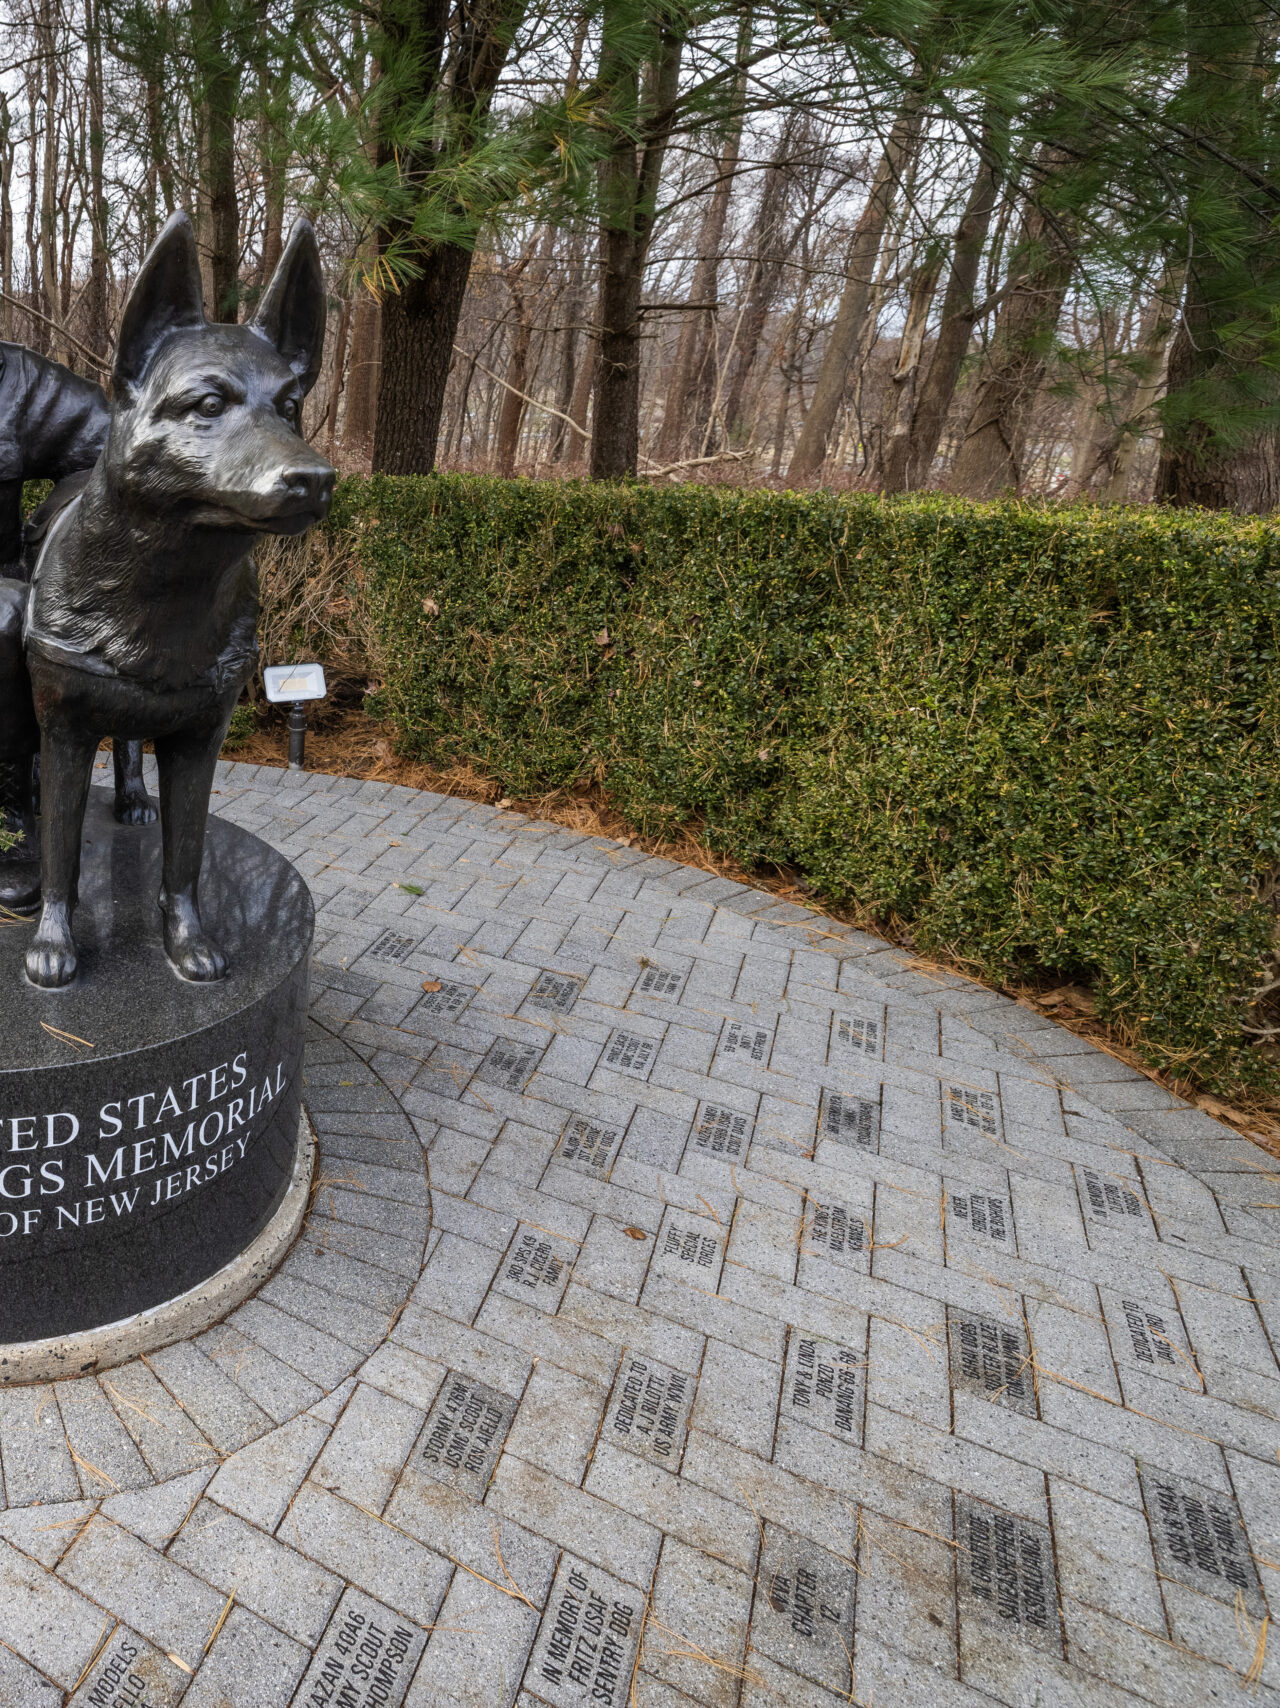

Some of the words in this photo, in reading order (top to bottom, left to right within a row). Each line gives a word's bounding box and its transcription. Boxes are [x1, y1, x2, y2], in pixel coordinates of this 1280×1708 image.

[98, 1051, 248, 1139] STATES
[83, 1061, 287, 1189] MEMORIAL
[583, 1127, 602, 1148] MARINE
[732, 1117, 747, 1135] DAVIS
[562, 1137, 580, 1159] MAJOR
[591, 1146, 609, 1168] SCOUT
[600, 1130, 616, 1147] DOGS
[727, 1134, 741, 1155] SCOUT
[55, 1187, 142, 1230] NEW
[150, 1131, 252, 1205] JERSEY
[1083, 1170, 1099, 1179] OF
[953, 1196, 967, 1219] NEVER
[1086, 1179, 1104, 1208] MEMORY
[1104, 1184, 1124, 1214] CLIFFORD
[971, 1193, 986, 1234] FORGOTTEN
[1093, 1208, 1107, 1217] IN
[522, 1235, 537, 1248] K9
[812, 1228, 827, 1243] THE
[830, 1206, 846, 1252] MAELSTROM
[848, 1219, 864, 1253] KENNELS
[990, 1226, 1006, 1241] THE
[514, 1248, 531, 1265] SPS
[530, 1243, 552, 1272] CICERO
[681, 1231, 701, 1262] SPECIAL
[698, 1237, 717, 1268] FORCES
[506, 1264, 523, 1282] 3RD
[542, 1256, 564, 1287] FAMILY
[1122, 1300, 1143, 1313] TO
[961, 1323, 977, 1348] DOGS
[980, 1322, 998, 1354] BLAZE
[1126, 1313, 1154, 1364] DEDICATED
[1152, 1338, 1175, 1364] JAKE
[798, 1339, 816, 1369] LINDA
[797, 1371, 813, 1380] &
[816, 1363, 834, 1400] PONZO
[983, 1354, 1002, 1391] BUSTER
[614, 1377, 643, 1434] DEDICATED
[630, 1361, 647, 1375] TO
[793, 1379, 811, 1408] TONY
[835, 1384, 854, 1432] DANANG
[443, 1433, 469, 1468] USMC
[459, 1394, 485, 1432] SCOUT
[636, 1425, 652, 1436] A
[640, 1414, 655, 1425] J
[657, 1404, 679, 1439] ARMY
[423, 1413, 454, 1463] STORMY
[464, 1446, 485, 1474] RON
[476, 1408, 503, 1447] AIELLO
[653, 1437, 671, 1456] US
[1156, 1482, 1181, 1515] MAX
[1163, 1518, 1184, 1530] &
[1181, 1496, 1220, 1575] BONGIORNO
[1208, 1504, 1239, 1556] FAMILY
[970, 1514, 992, 1582] GRATITUDE
[1165, 1532, 1193, 1568] ASIA
[569, 1568, 588, 1591] OF
[994, 1515, 1020, 1623] SAVEASHEPHERD
[1222, 1556, 1248, 1589] OUR
[791, 1568, 817, 1636] CHAPTER
[972, 1581, 992, 1600] IN
[547, 1589, 582, 1663] MEMORY
[582, 1591, 608, 1637] USAF
[820, 1604, 840, 1624] 12
[351, 1622, 386, 1681] SCOUT
[362, 1625, 413, 1708] HOMPSON
[568, 1636, 597, 1687] FRITZ
[592, 1635, 624, 1706] SENTRY
[609, 1601, 633, 1638] DOG
[306, 1656, 345, 1708] AZAN
[541, 1661, 563, 1686] IN
